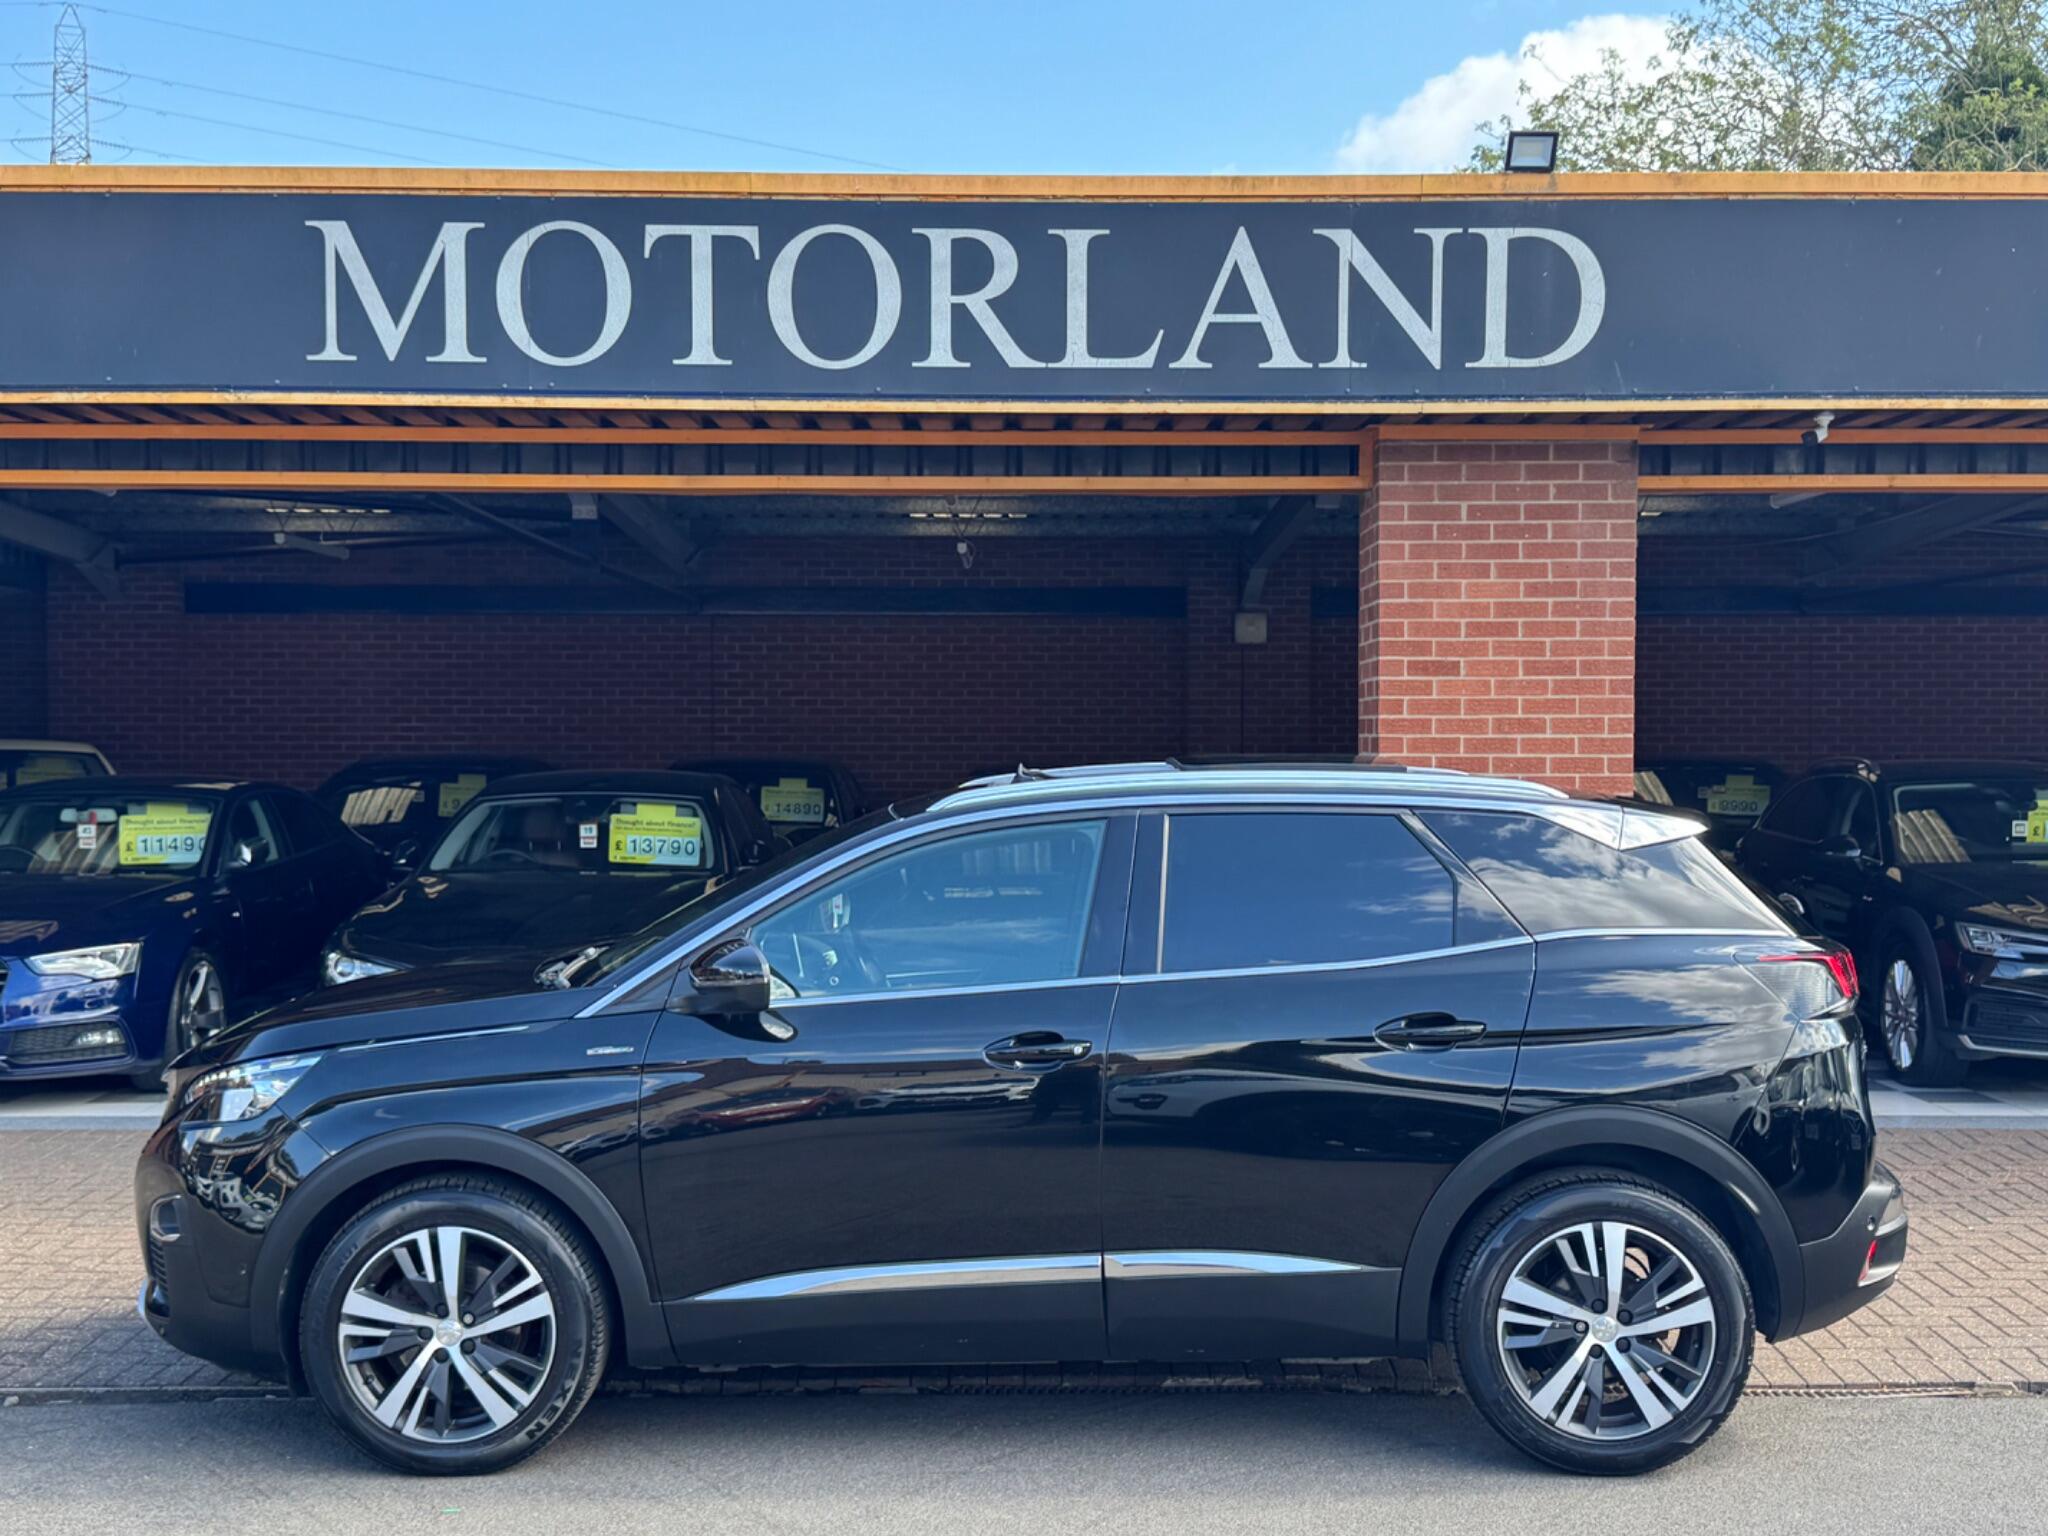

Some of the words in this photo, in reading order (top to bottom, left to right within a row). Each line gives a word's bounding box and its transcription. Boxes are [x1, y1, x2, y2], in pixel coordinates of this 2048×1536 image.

[304, 218, 1606, 371] MOTORLAND
[630, 838, 696, 856] 13790
[525, 1342, 583, 1440] NEXEN
